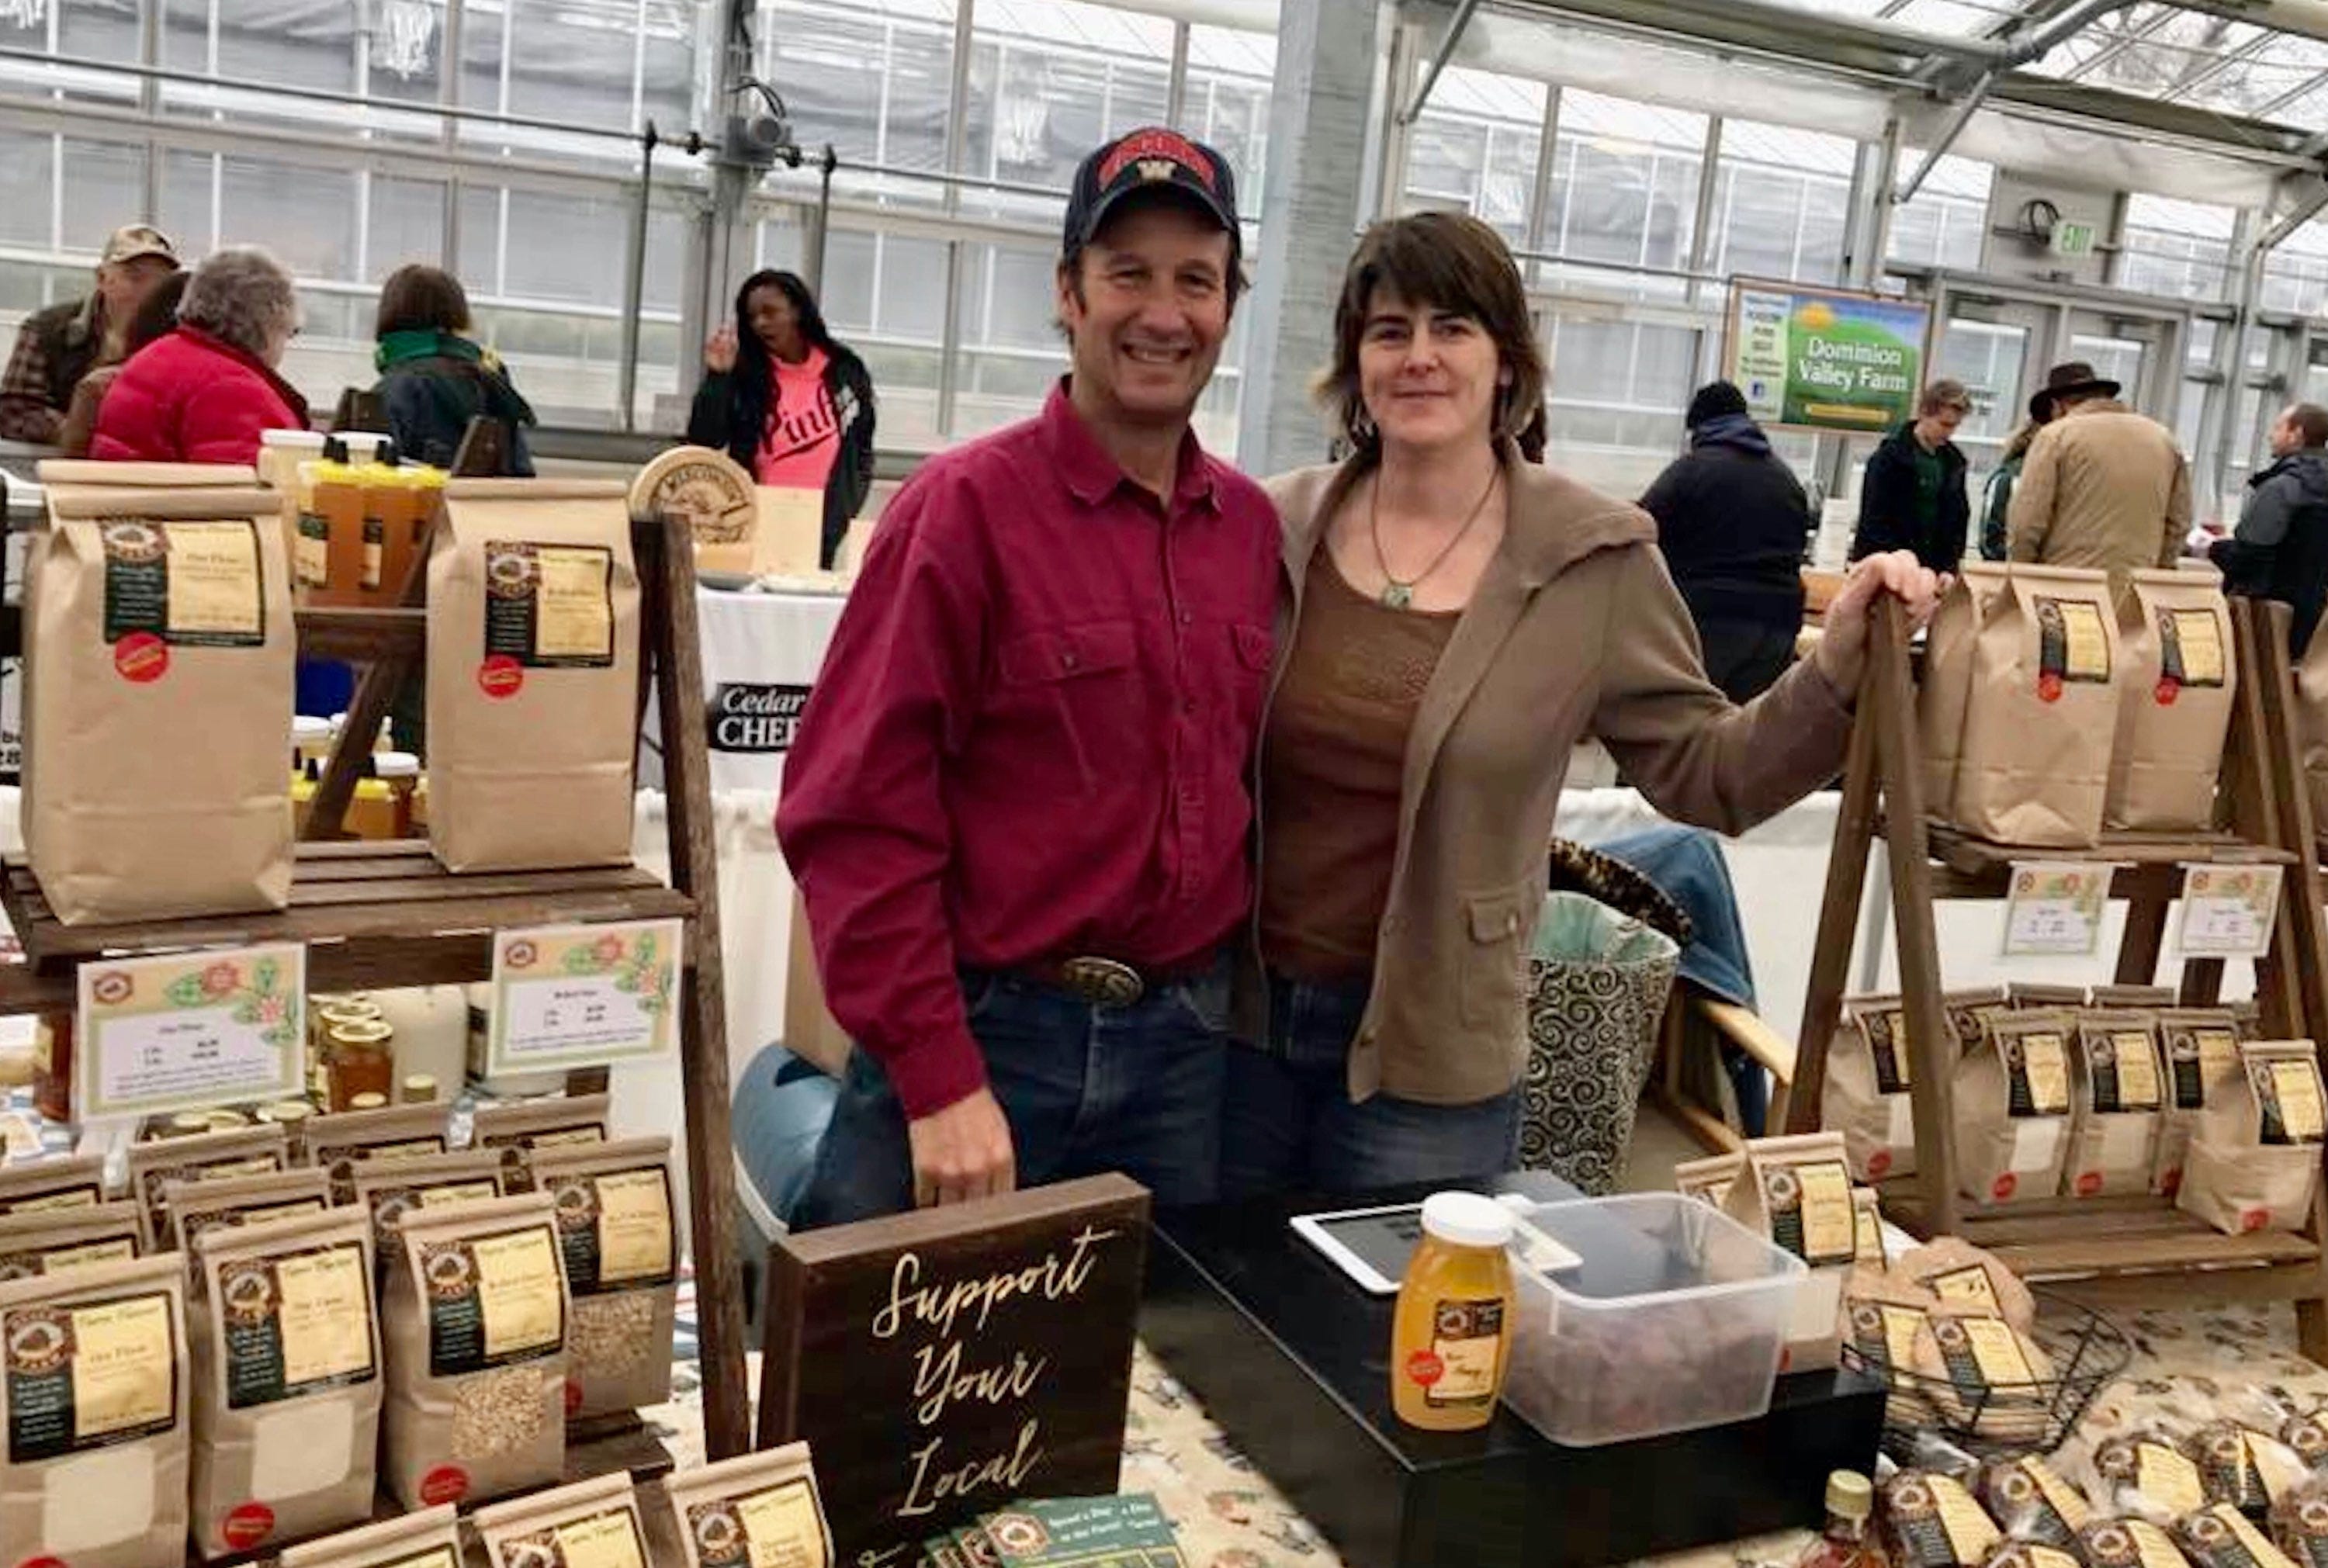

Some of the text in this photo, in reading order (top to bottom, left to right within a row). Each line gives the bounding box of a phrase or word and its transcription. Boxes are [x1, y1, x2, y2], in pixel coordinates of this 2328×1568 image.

[1798, 358, 1908, 393] Valley Farm
[1808, 336, 1903, 365] Dominion
[722, 686, 806, 715] Cedar
[871, 1225, 1117, 1338] Support
[912, 1341, 1047, 1425] Your
[895, 1418, 1044, 1518] Local
